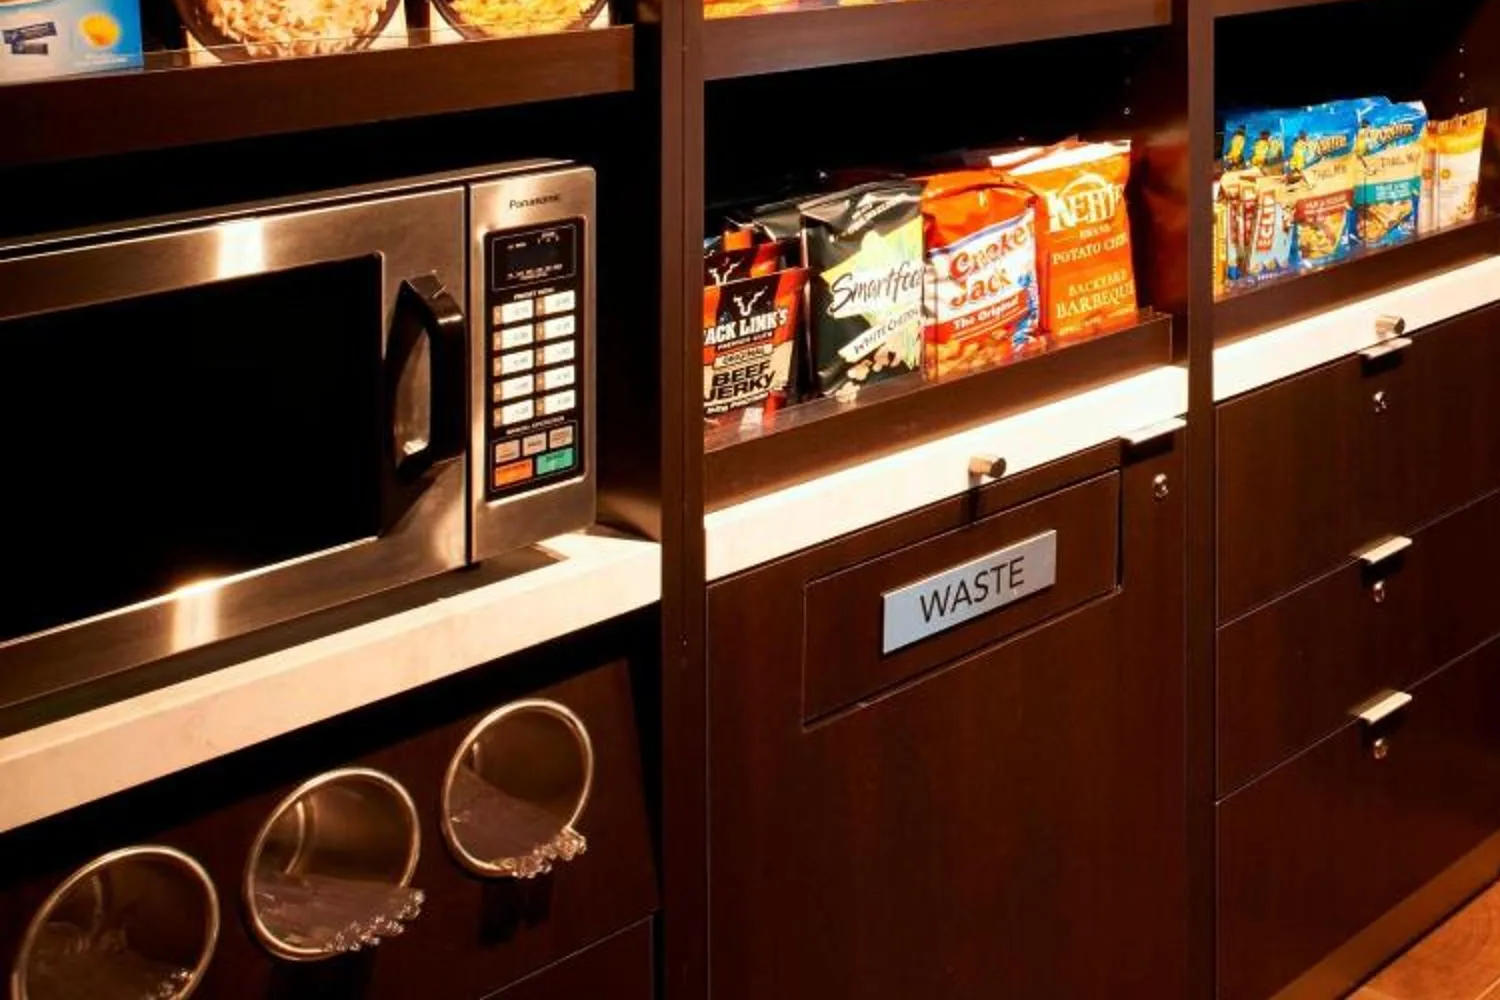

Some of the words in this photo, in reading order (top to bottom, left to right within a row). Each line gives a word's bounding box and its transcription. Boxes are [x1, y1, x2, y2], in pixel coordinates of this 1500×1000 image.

[704, 320, 737, 345] ACK
[739, 308, 789, 338] LINK'S
[709, 370, 776, 400] JERKY
[712, 360, 771, 387] BEEF
[919, 555, 1025, 624] WASTE
